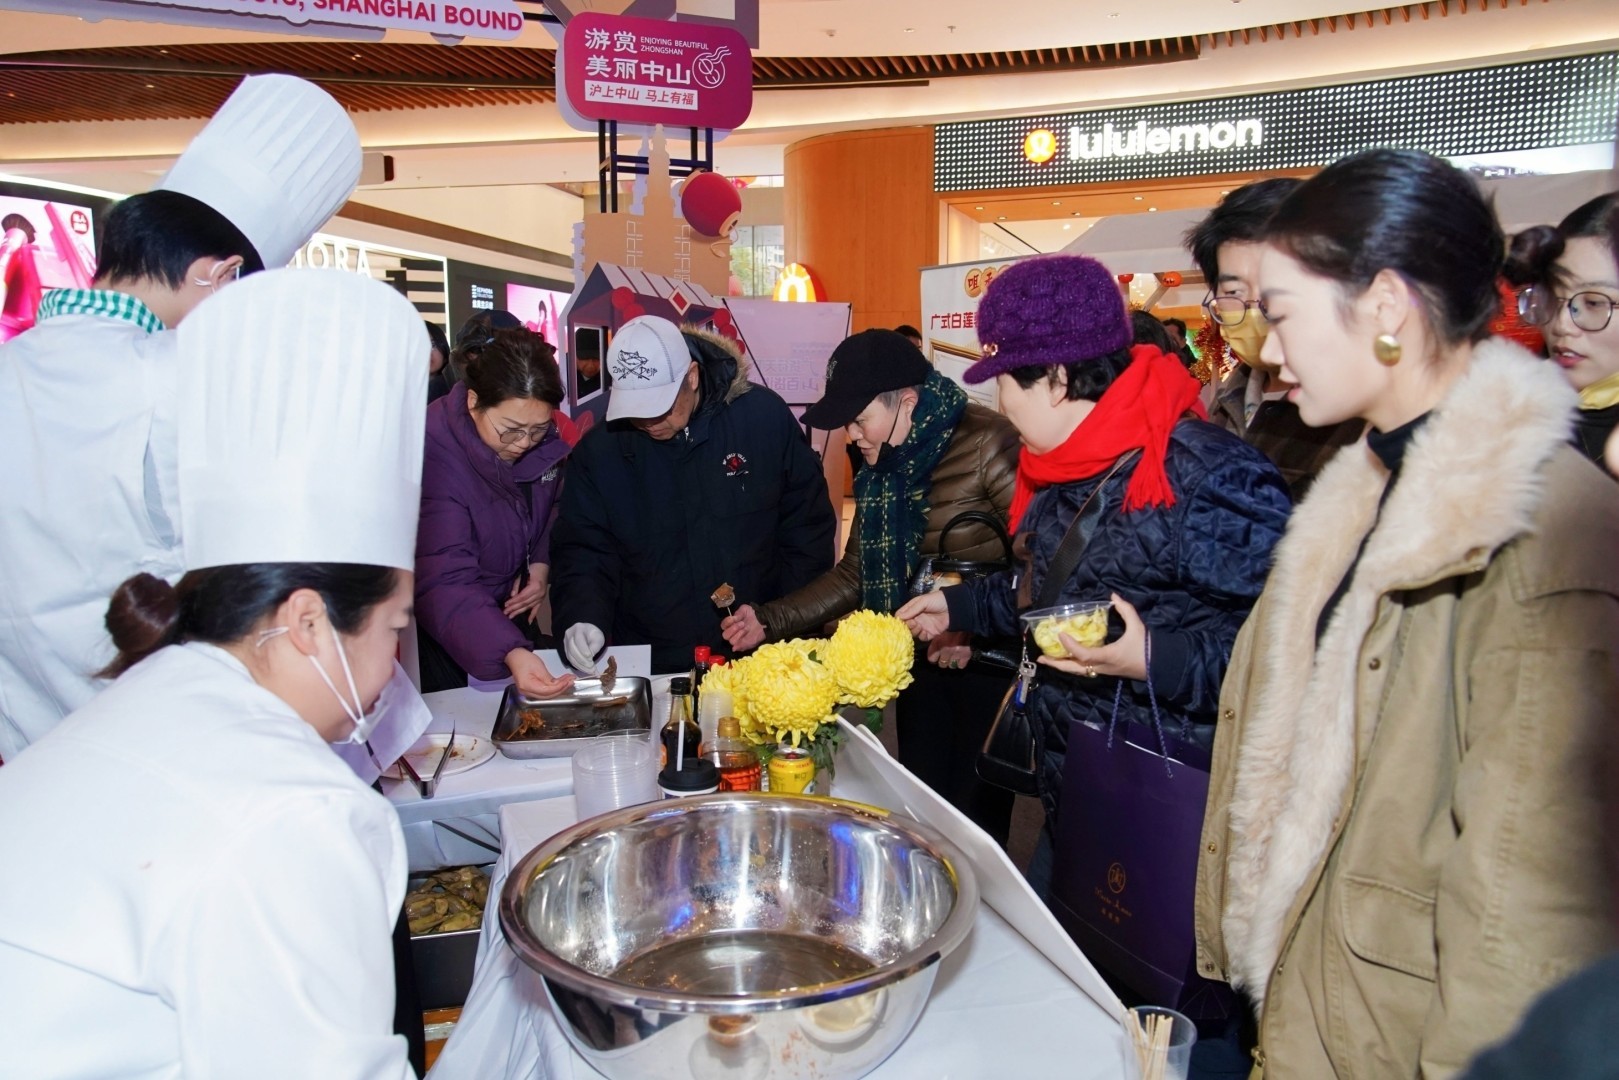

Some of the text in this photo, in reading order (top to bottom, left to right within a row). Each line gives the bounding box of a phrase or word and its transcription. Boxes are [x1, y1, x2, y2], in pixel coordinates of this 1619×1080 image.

[313, 0, 436, 22] SHANGHAI
[444, 5, 523, 31] BOUND
[585, 27, 638, 54] 游赏
[640, 36, 709, 50] ENJOYING BEAUTIFUL
[640, 44, 684, 56] ZHONGSHAN
[585, 54, 691, 85] 美丽中山
[589, 84, 695, 106] 沪上中山 马上有福
[1070, 118, 1263, 160] lululemon
[931, 311, 978, 330] 广式白莲
